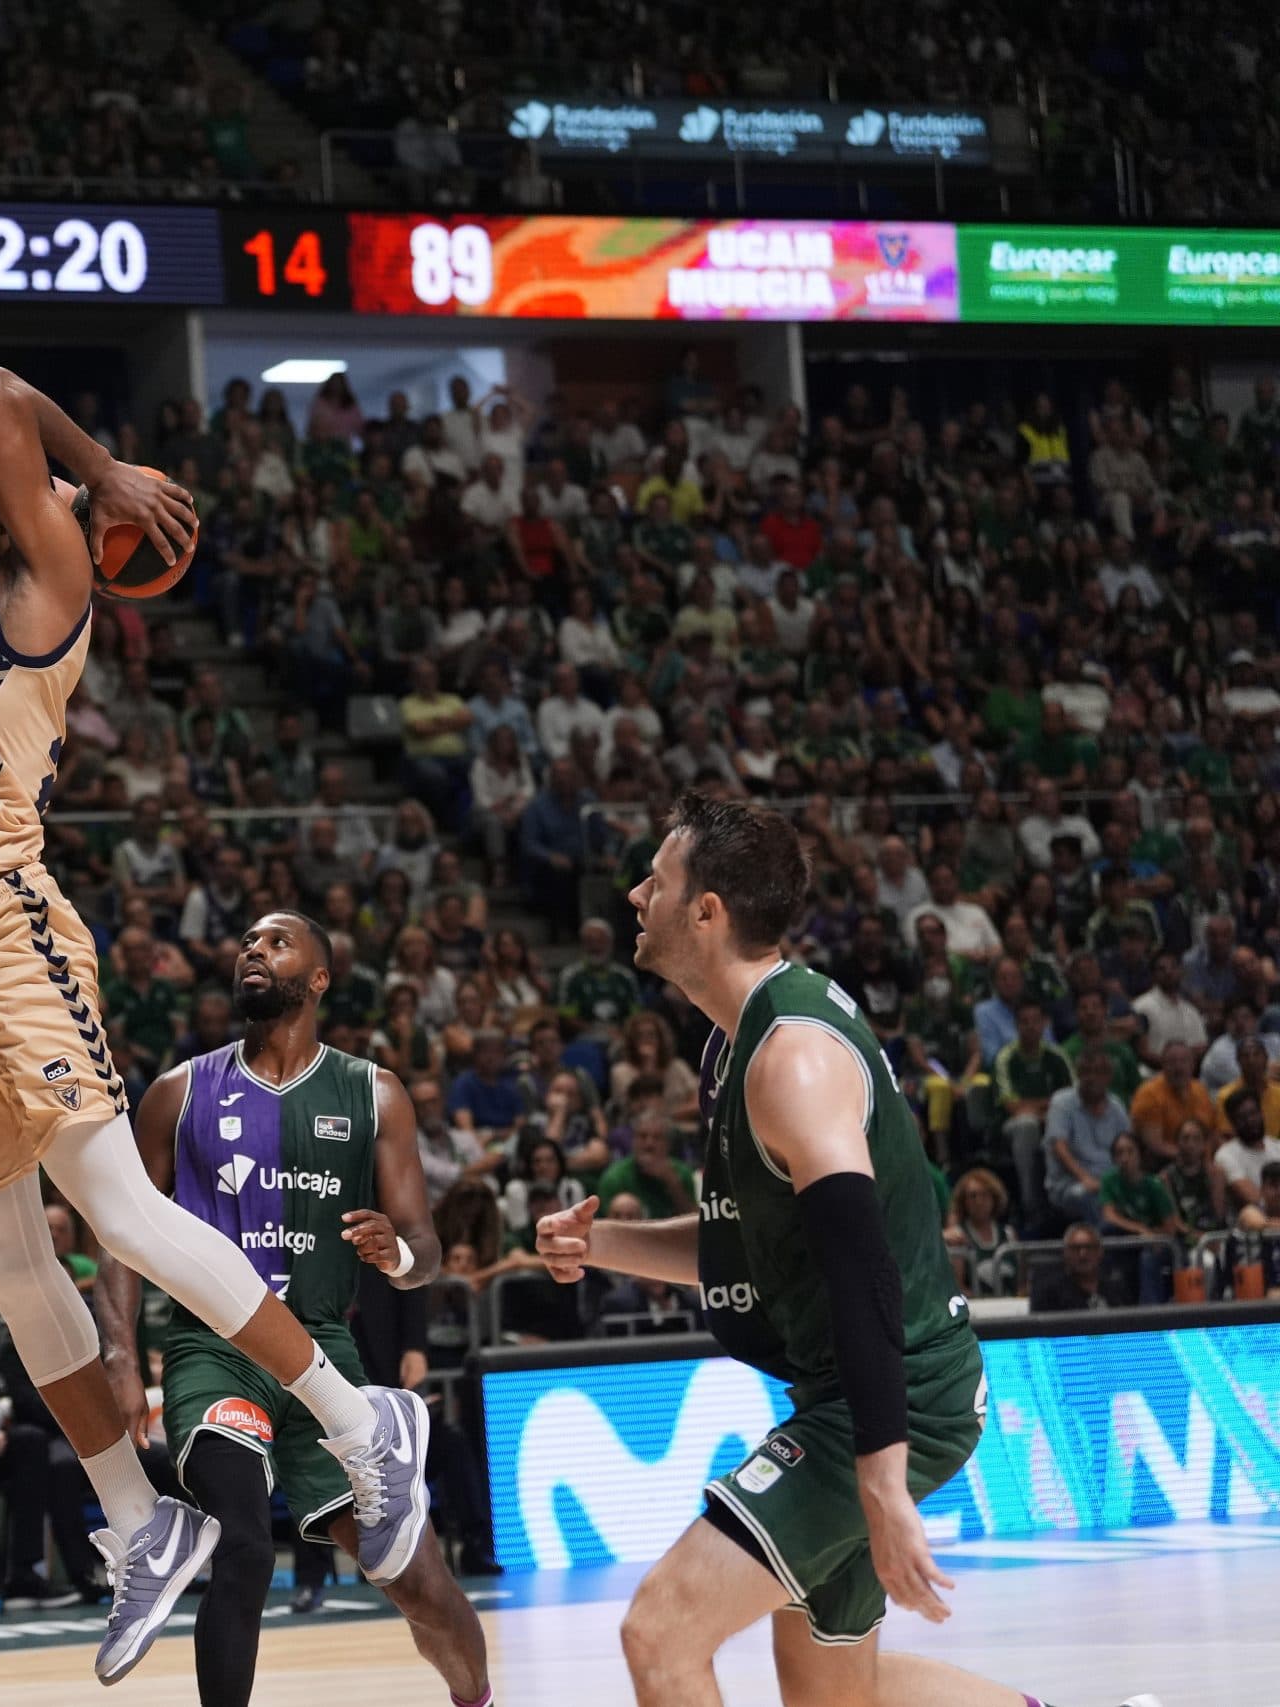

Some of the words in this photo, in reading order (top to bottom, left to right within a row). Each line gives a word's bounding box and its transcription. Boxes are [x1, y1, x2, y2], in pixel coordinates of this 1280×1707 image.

[243, 230, 327, 296] 14
[410, 223, 492, 305] 89
[707, 230, 834, 268] UCAM
[990, 241, 1117, 281] Europcar
[668, 268, 835, 308] MURCIA
[47, 1065, 66, 1080] acb
[259, 1166, 342, 1199] Unicaja
[770, 1441, 792, 1460] acb
